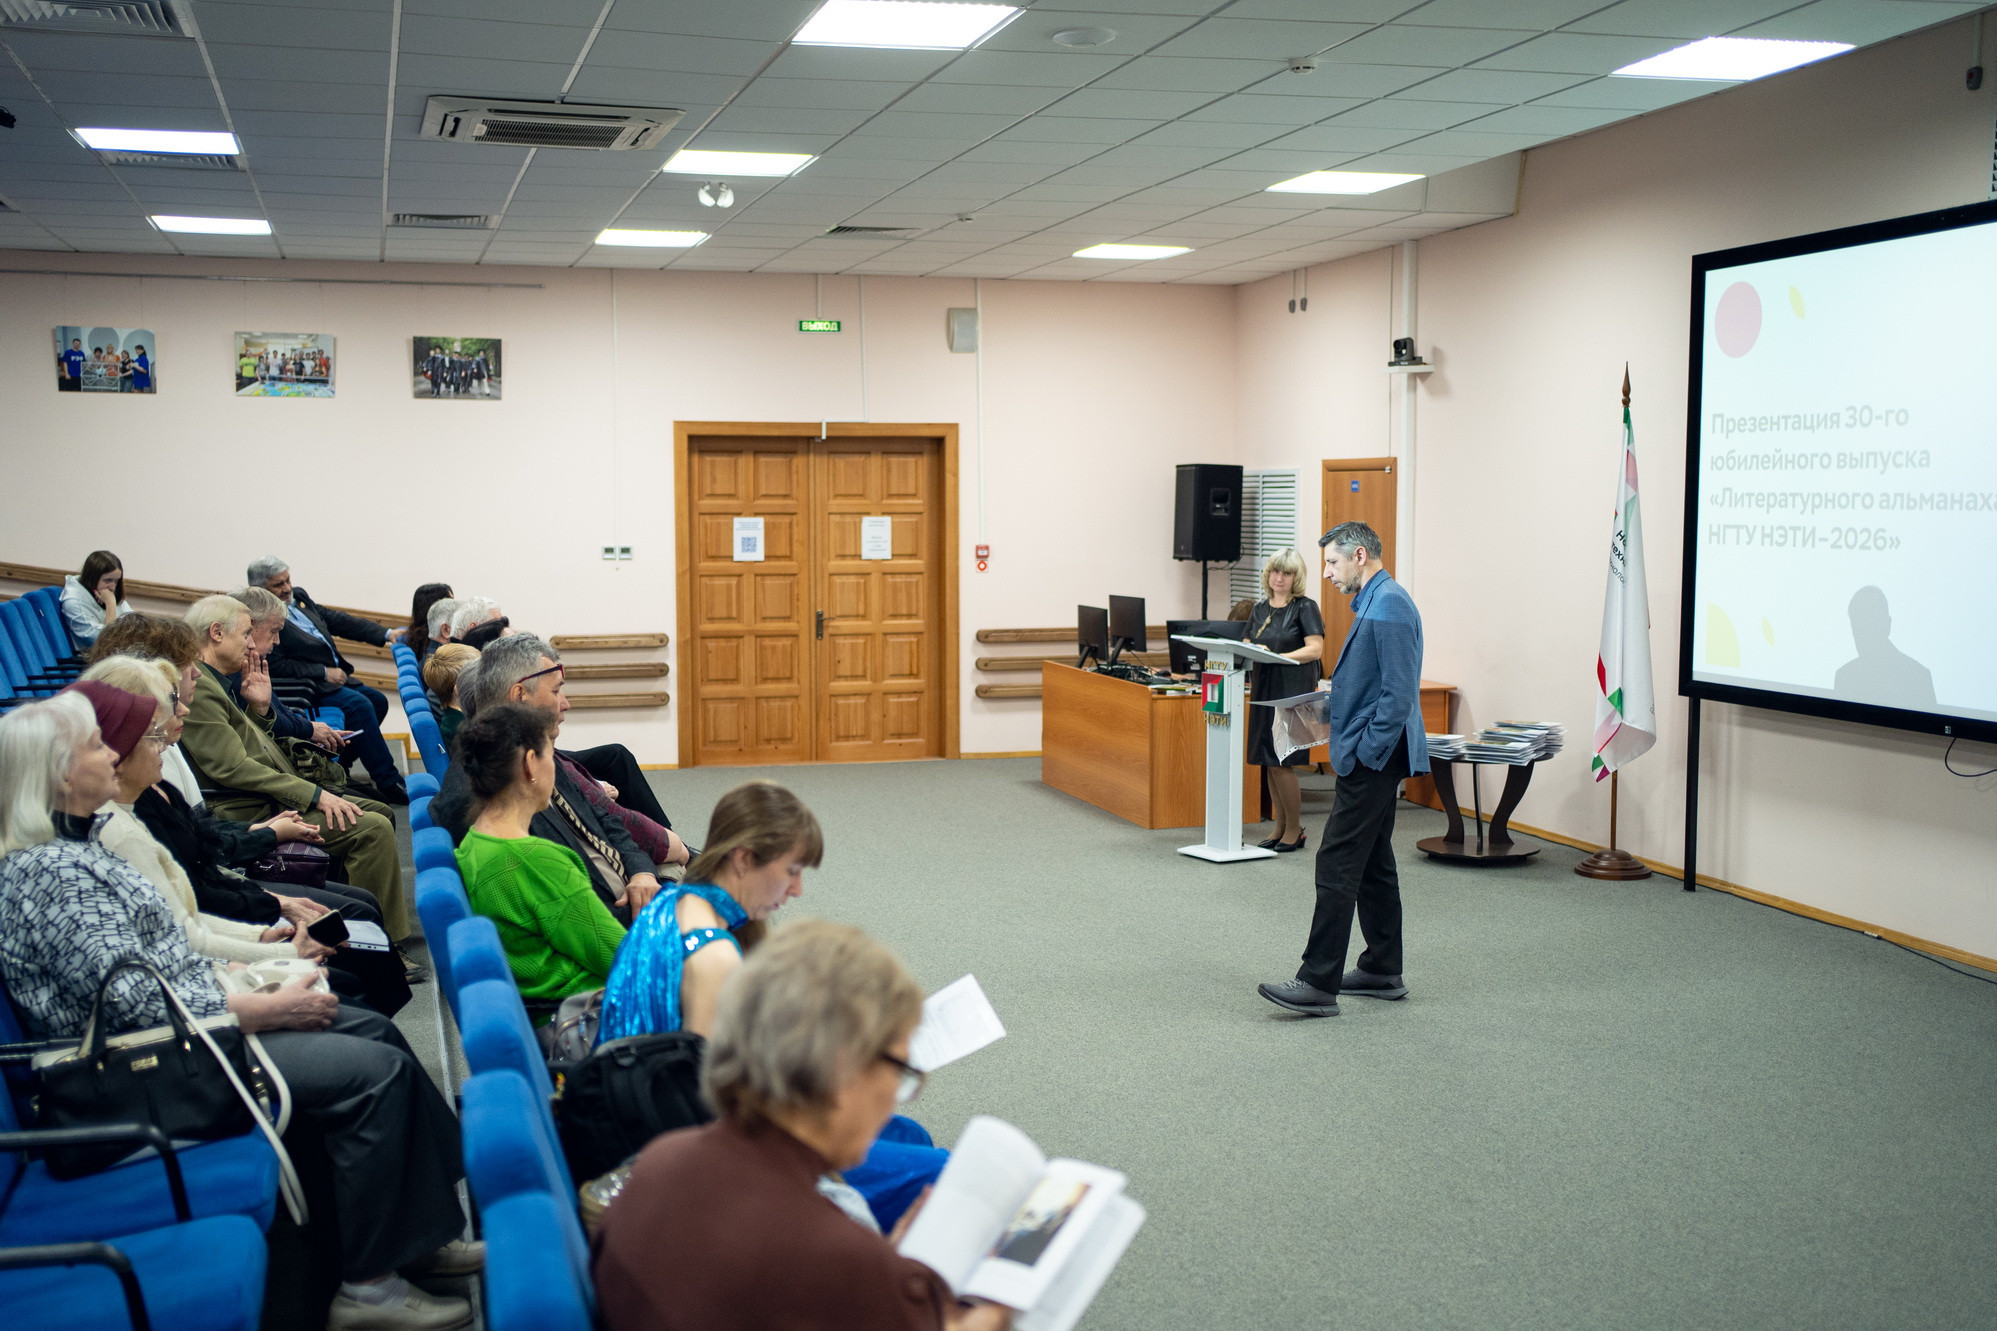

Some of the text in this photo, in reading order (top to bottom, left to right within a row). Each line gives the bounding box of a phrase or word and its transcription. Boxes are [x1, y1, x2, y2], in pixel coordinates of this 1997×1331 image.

[801, 321, 838, 331] ВЫХОД
[1711, 404, 1910, 439] Презентация 30-го
[1710, 448, 1931, 475] юбилейного выпуска
[1709, 487, 1997, 515] «Литературного альманах
[1707, 524, 1757, 545] НГТУ
[1204, 660, 1229, 671] НГТУ
[1204, 713, 1228, 726] НЭТИ
